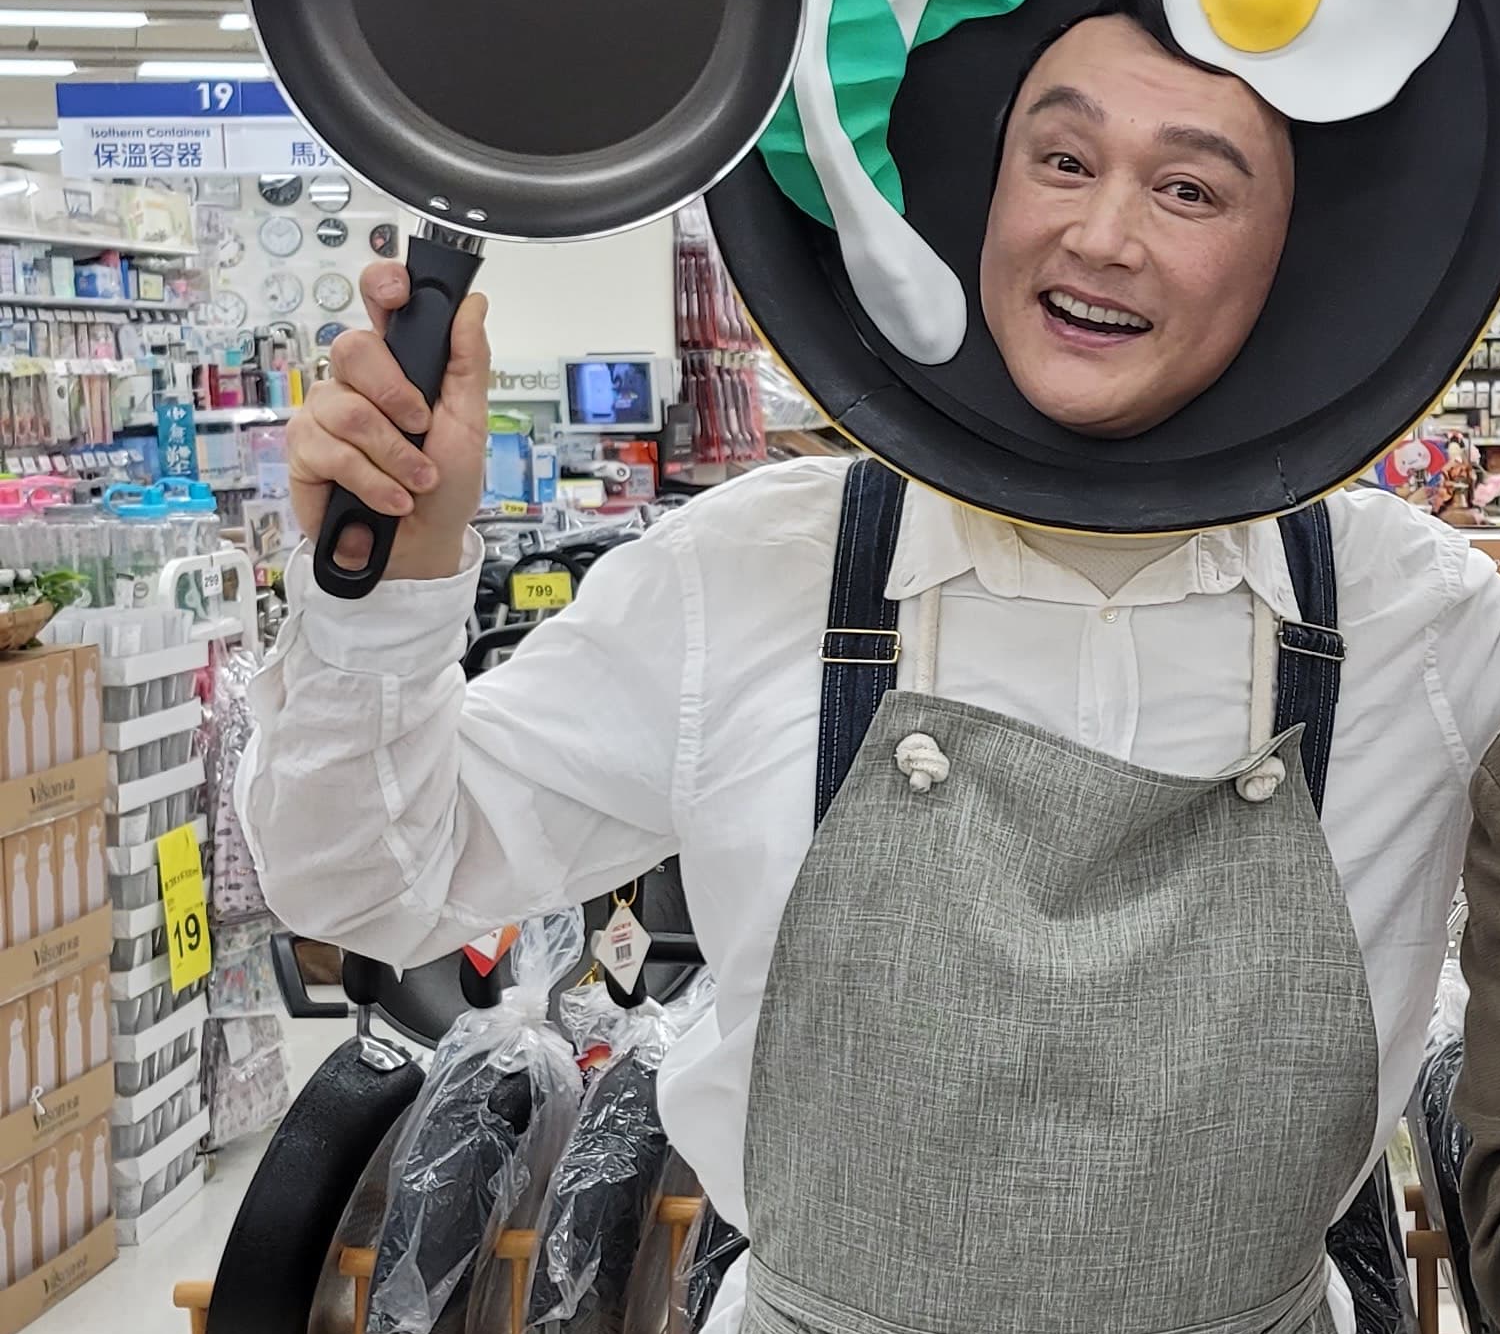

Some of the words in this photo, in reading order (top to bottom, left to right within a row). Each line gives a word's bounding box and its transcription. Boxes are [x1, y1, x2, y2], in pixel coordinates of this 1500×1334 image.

[196, 82, 234, 110] 19
[91, 127, 143, 138] Isotherm
[147, 127, 211, 138] Containers
[94, 142, 203, 168] 保溫容器
[526, 585, 553, 597] 799
[174, 913, 201, 958] 19
